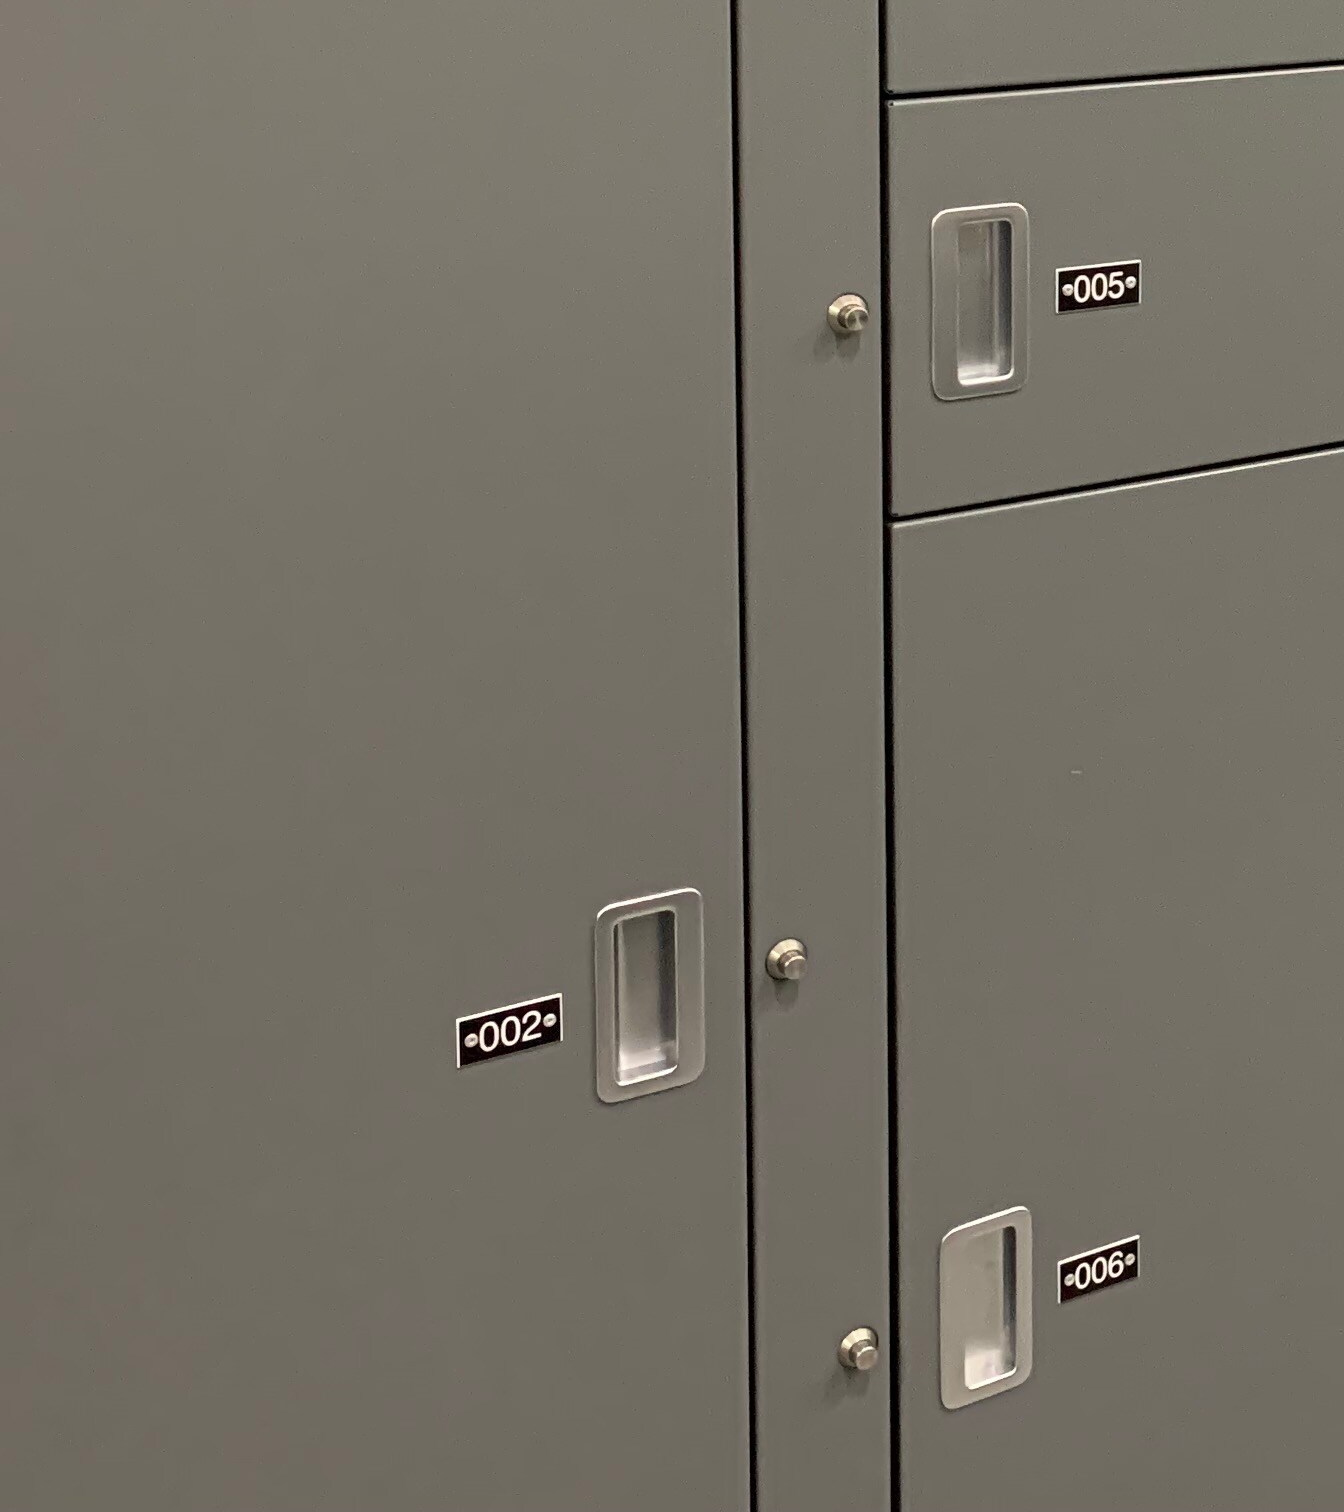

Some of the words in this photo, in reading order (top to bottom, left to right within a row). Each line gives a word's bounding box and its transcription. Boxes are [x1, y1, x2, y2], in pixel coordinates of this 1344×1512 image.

[1073, 271, 1124, 303] 005
[479, 1010, 542, 1051] 002
[1075, 1251, 1125, 1290] 006
